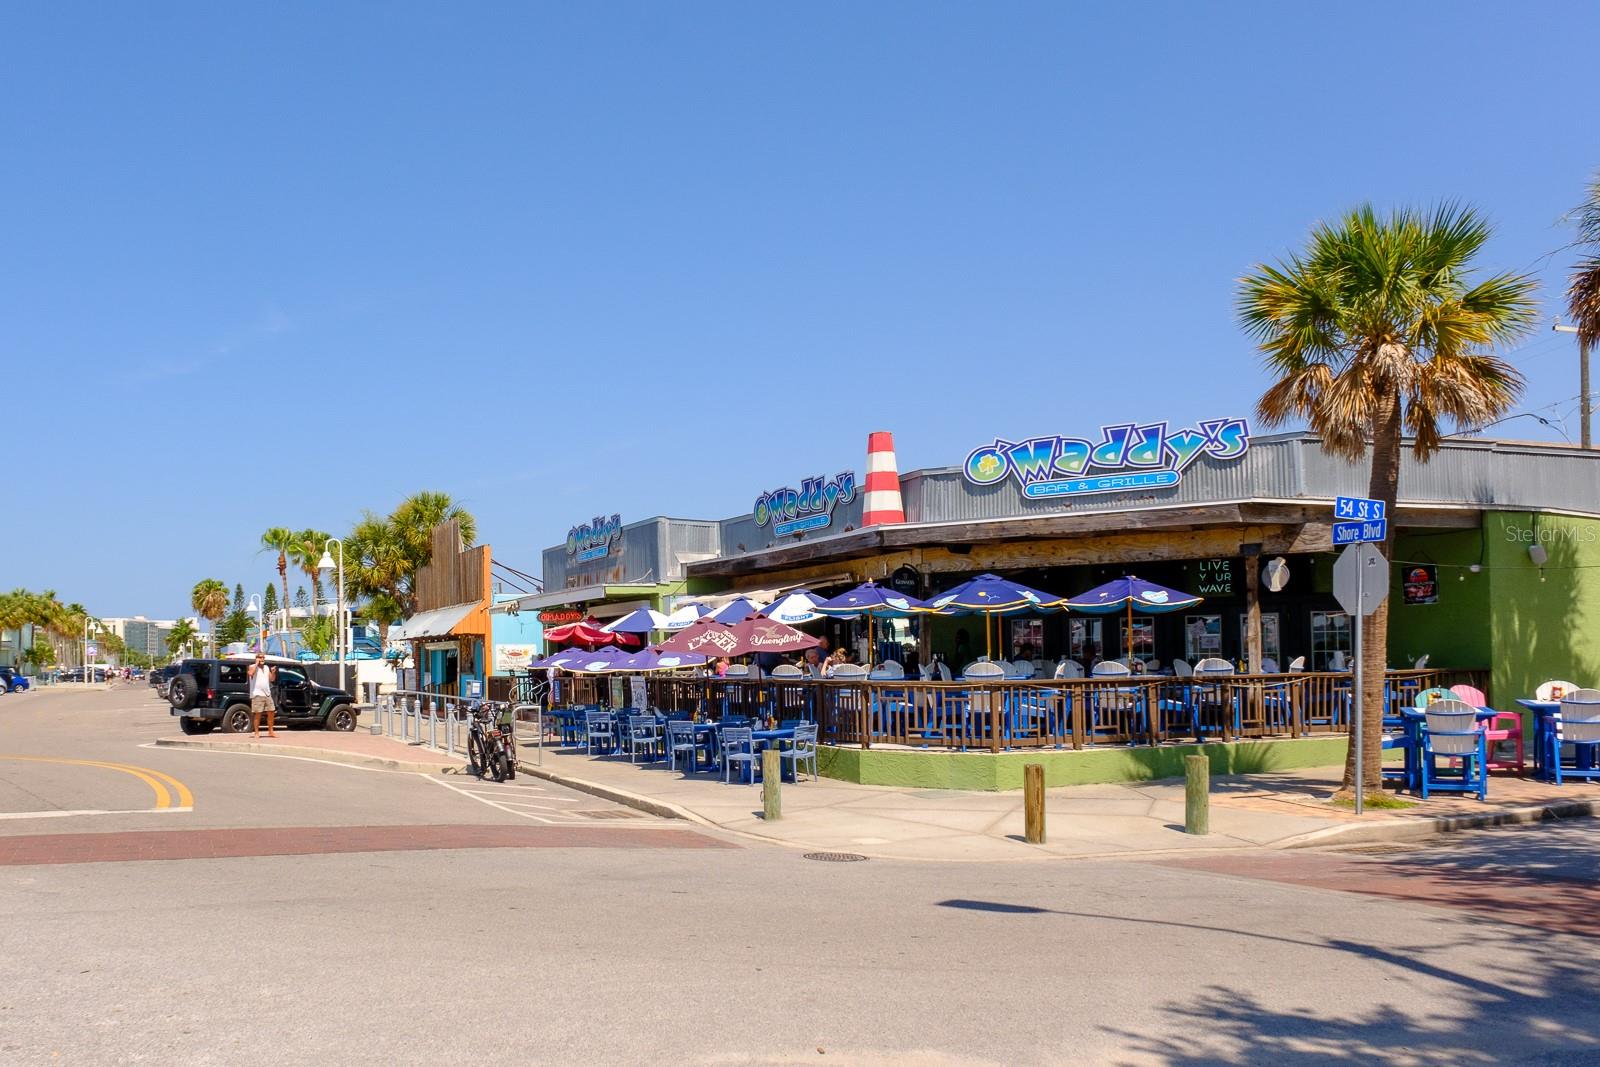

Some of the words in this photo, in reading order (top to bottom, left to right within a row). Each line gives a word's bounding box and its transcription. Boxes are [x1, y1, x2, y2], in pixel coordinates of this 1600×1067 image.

[964, 418, 1250, 486] O'Maddy's
[1033, 483, 1070, 494] BAR
[1078, 482, 1088, 490] &
[1097, 474, 1169, 488] GRILLE
[1340, 499, 1353, 516] 54
[1358, 501, 1369, 518] St
[1373, 502, 1380, 519] S
[1337, 525, 1359, 541] Shore
[1362, 522, 1381, 539] Blvd
[1199, 560, 1230, 571] LIVE
[1198, 583, 1231, 593] WAVE
[749, 632, 804, 646] Yuengling
